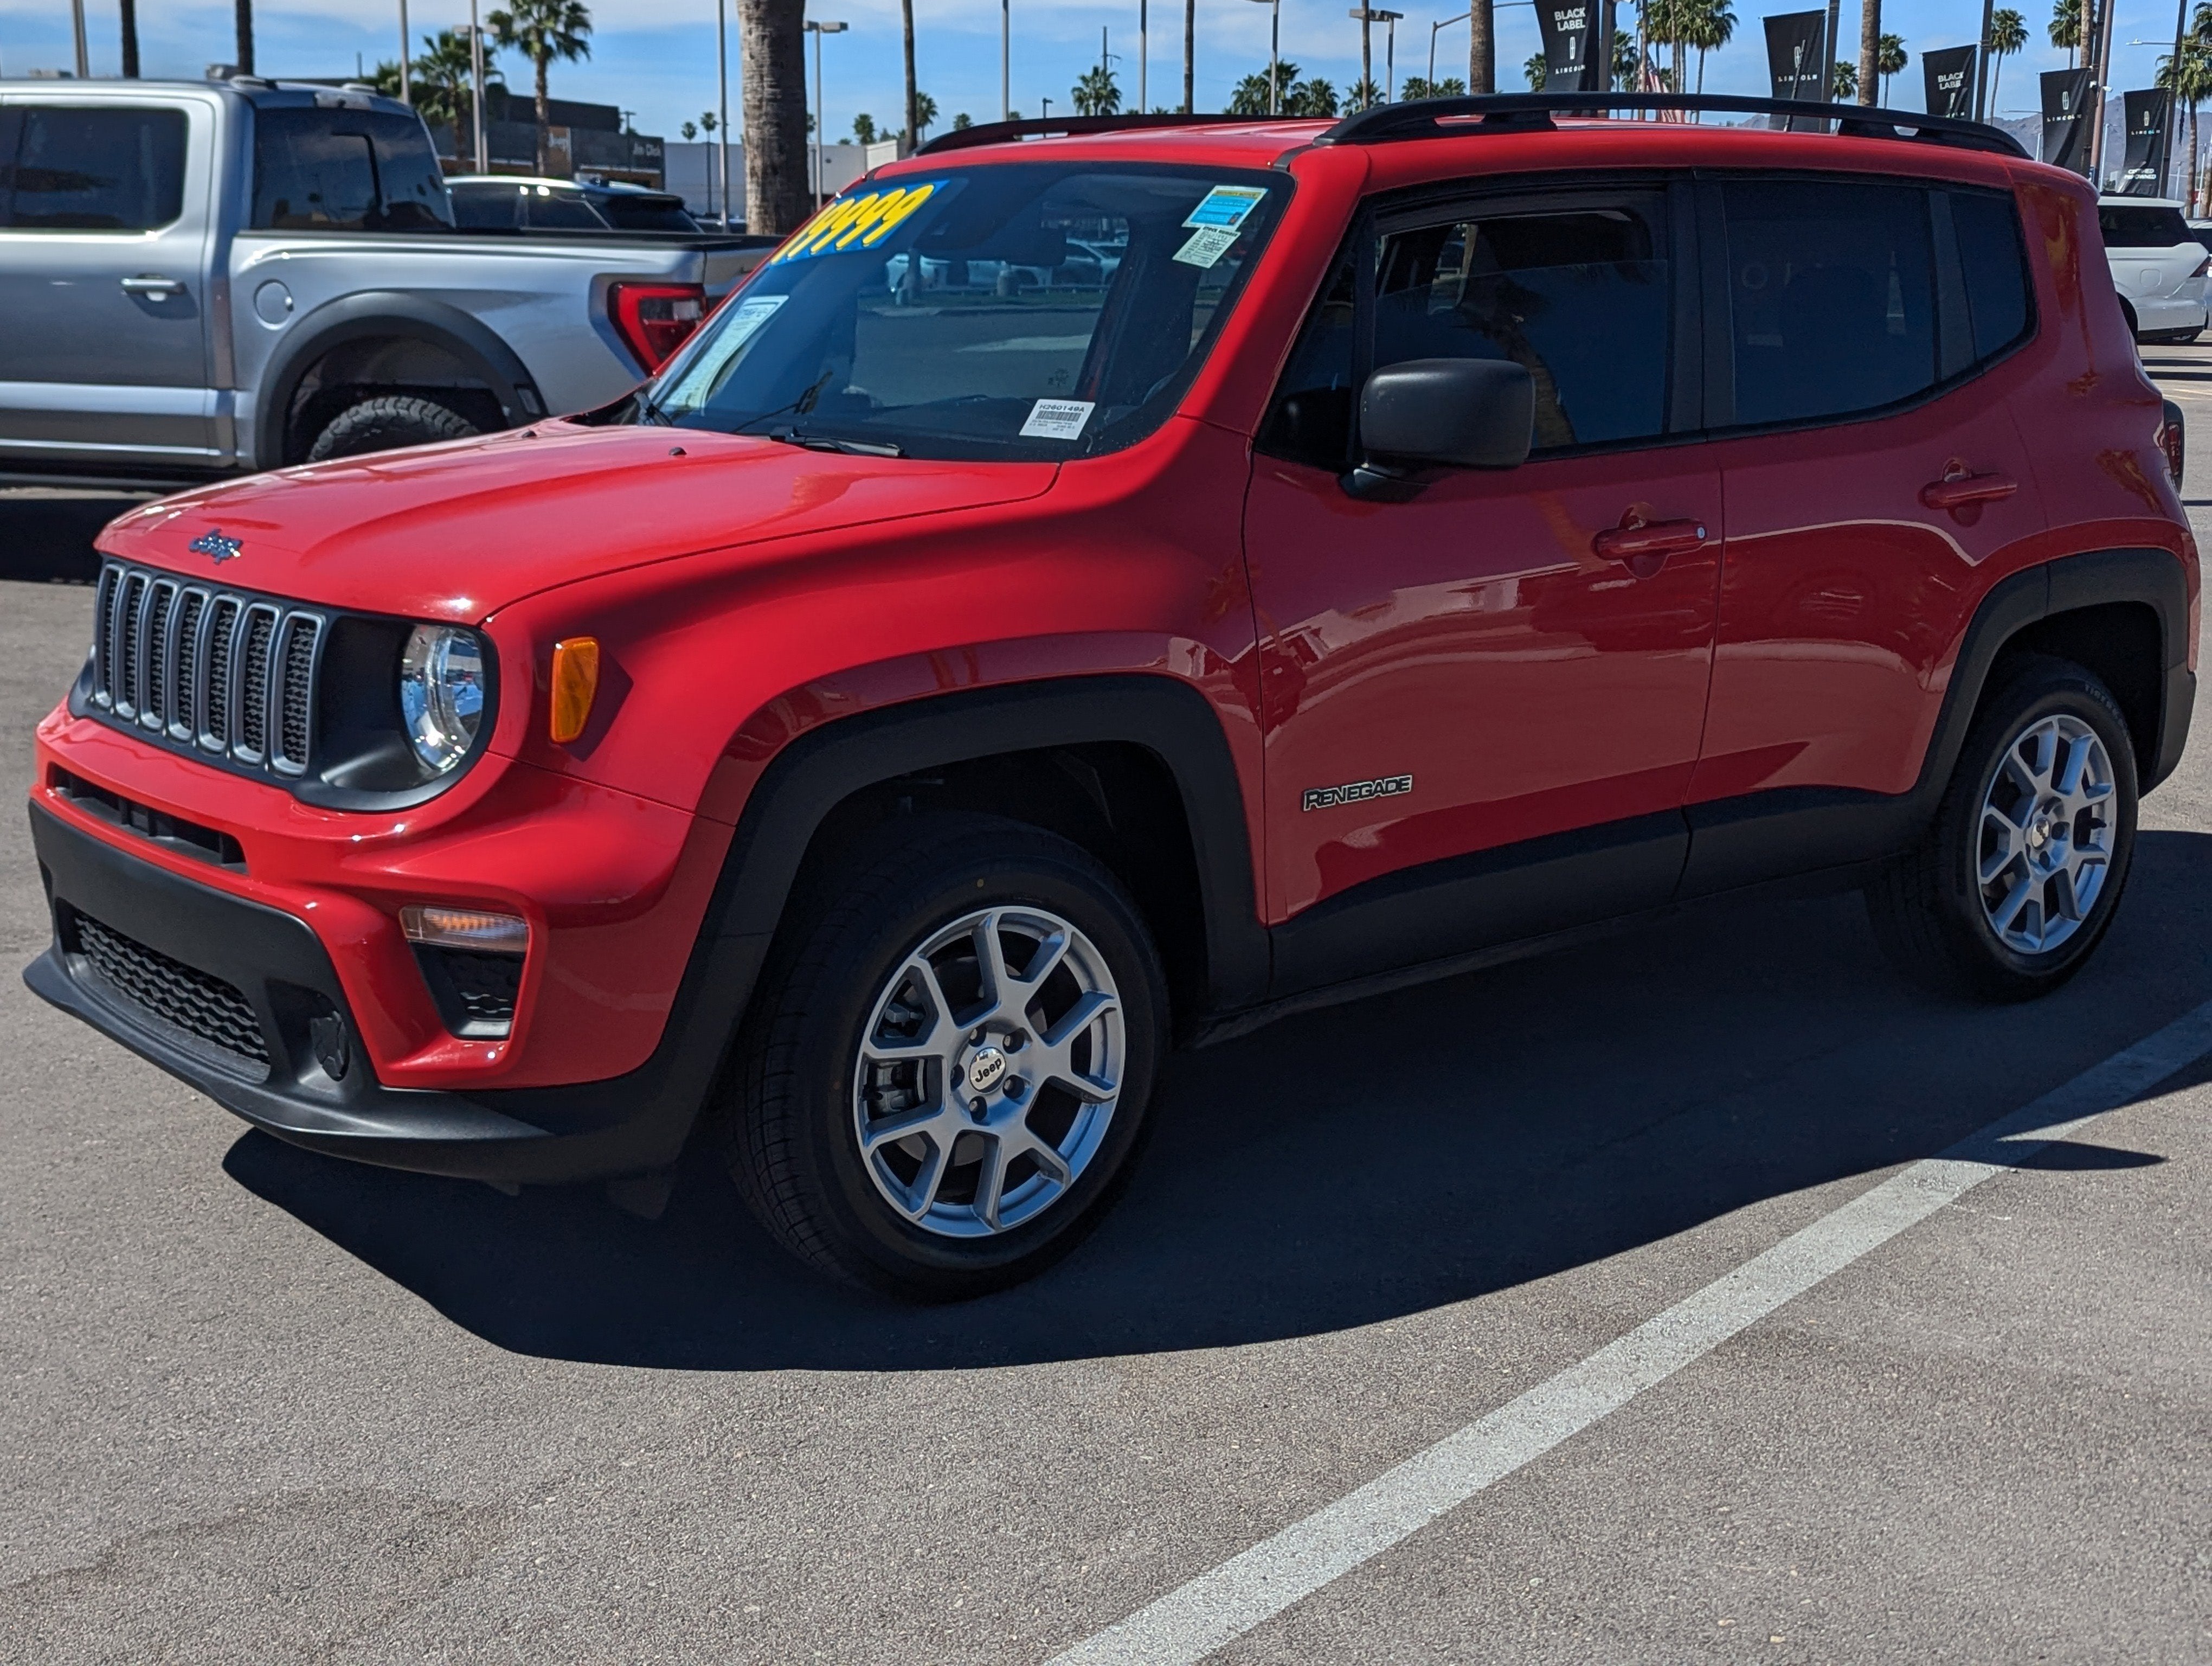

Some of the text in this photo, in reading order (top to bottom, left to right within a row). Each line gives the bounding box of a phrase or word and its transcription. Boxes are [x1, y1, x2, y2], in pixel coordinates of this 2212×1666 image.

[1554, 7, 1586, 21] BLACK
[1557, 18, 1586, 31] LABEL
[1778, 74, 1818, 82] LINOLN
[1303, 774, 1412, 811] RENEGADE
[975, 1058, 1002, 1082] Jeep
